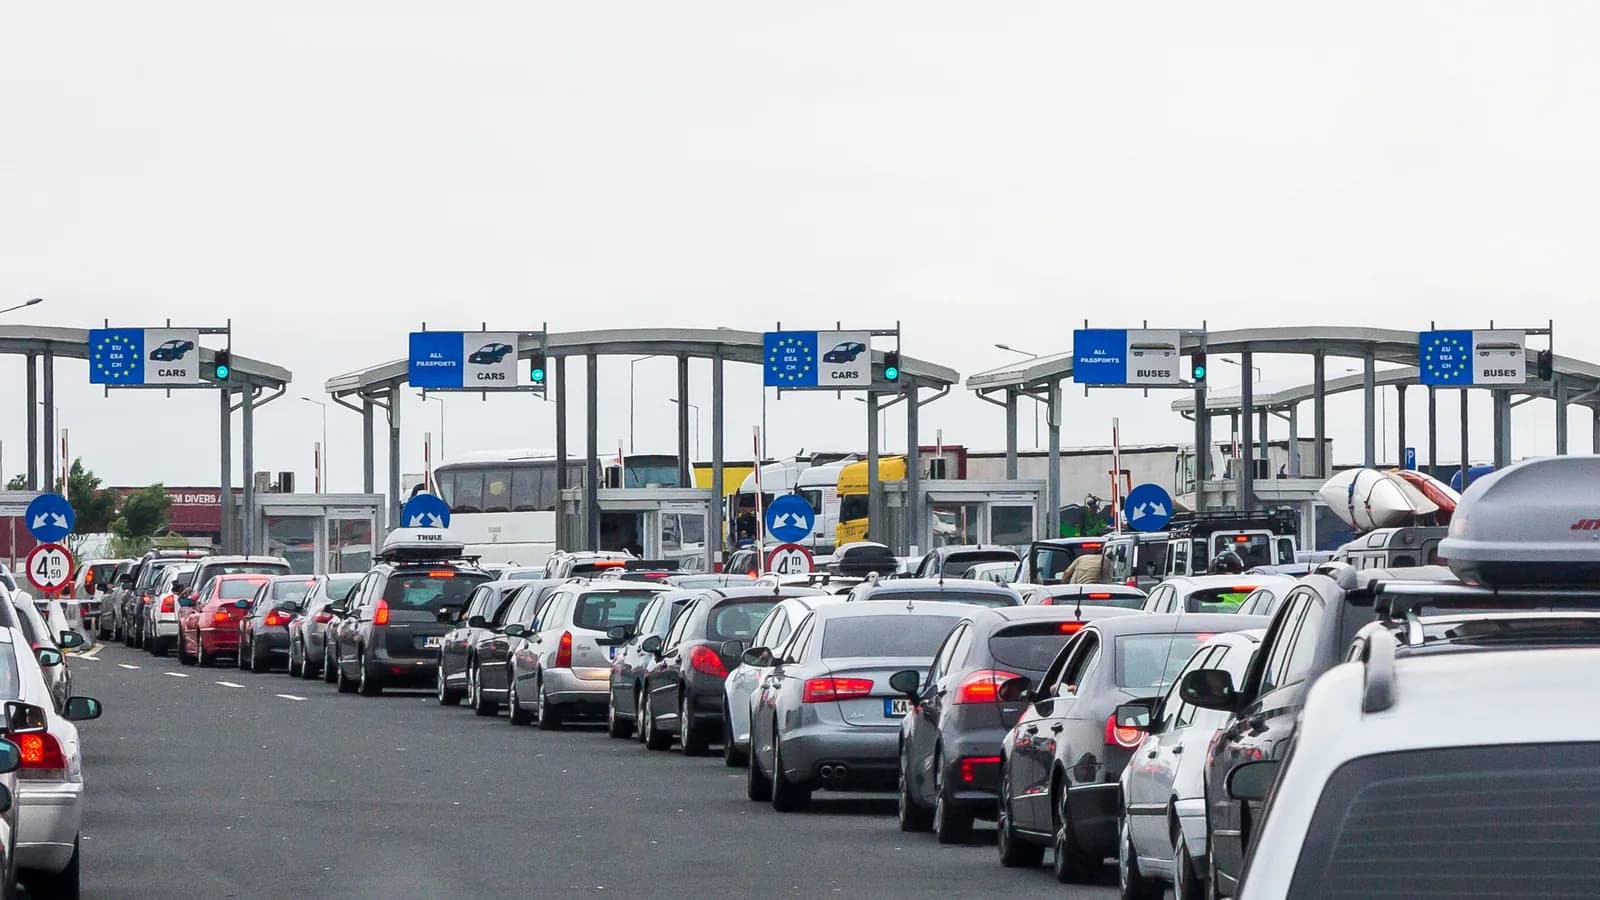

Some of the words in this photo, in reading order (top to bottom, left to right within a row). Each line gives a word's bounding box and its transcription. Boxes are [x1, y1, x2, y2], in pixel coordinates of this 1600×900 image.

[1408, 450, 1414, 464] P
[185, 494, 216, 503] DIVERS
[36, 556, 48, 578] 4
[893, 701, 907, 712] KA
